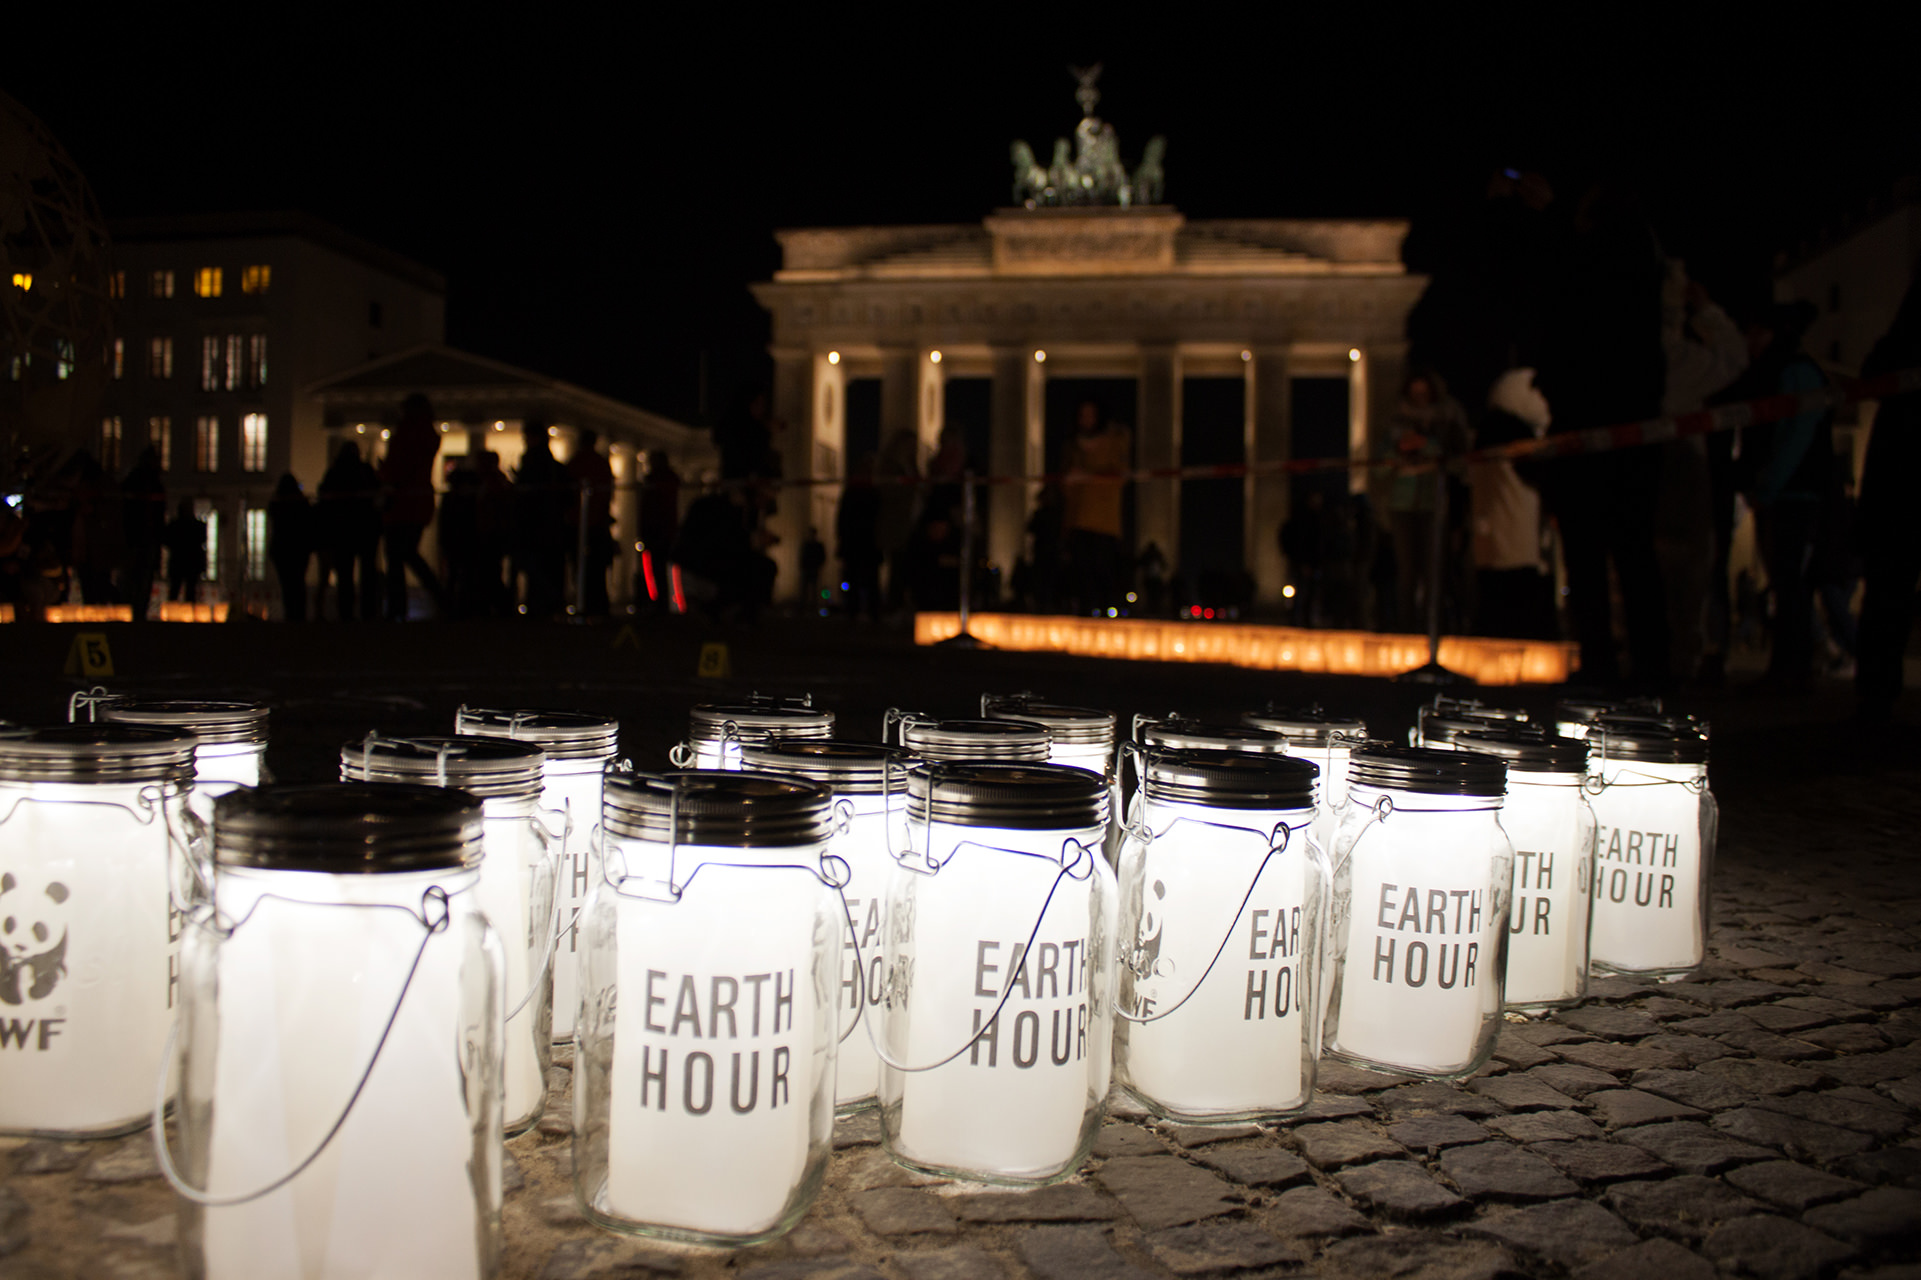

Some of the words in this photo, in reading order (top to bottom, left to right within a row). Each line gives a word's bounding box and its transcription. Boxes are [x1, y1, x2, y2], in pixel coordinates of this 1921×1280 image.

[87, 641, 106, 668] 5
[1249, 906, 1301, 961] EAR
[1377, 882, 1483, 935] EARTH
[974, 938, 1088, 999] EARTH
[1373, 936, 1479, 990] HOUR
[644, 968, 794, 1039] EARTH
[0, 1018, 66, 1051] WF
[970, 1003, 1087, 1069] HOUR
[640, 1045, 791, 1117] HOUR
